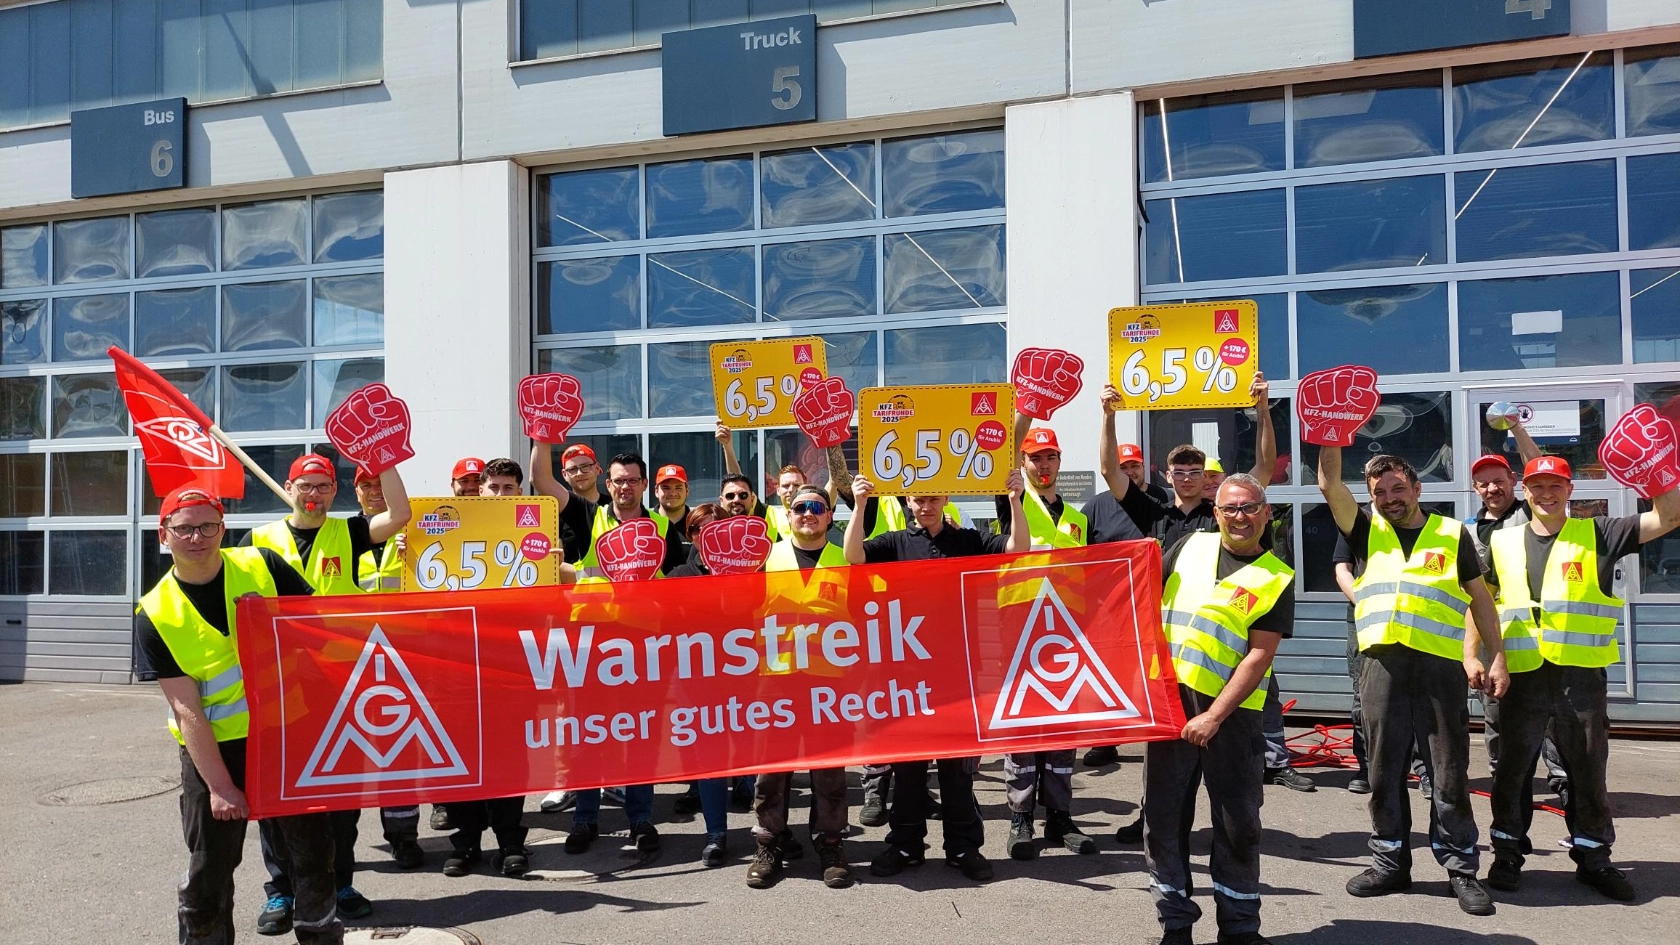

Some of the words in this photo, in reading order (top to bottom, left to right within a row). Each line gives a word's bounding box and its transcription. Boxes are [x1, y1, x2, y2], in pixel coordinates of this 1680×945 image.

[740, 27, 802, 50] Truck
[770, 65, 802, 110] 5
[144, 109, 175, 126] Bus
[150, 139, 174, 178] 6
[1121, 329, 1159, 337] TARIFRUNDE
[1016, 375, 1066, 402] KFZ-HANDWERK
[523, 405, 572, 423] KFZ-HANDWERK
[805, 411, 850, 430] KFZ-HANDWERK
[1303, 408, 1365, 421] KFZ-HANDWERK
[347, 422, 406, 455] KFZ-HANDWERK
[1623, 441, 1675, 479] KFZ-HANDWERK
[531, 539, 543, 547] 170
[607, 559, 657, 572] KFZ-HANDWERK
[708, 554, 761, 567] KFZ-HANDWERK
[518, 598, 932, 691] Warnstreik
[524, 709, 656, 749] unser
[670, 695, 796, 747] gutes
[811, 679, 936, 725] Recht
